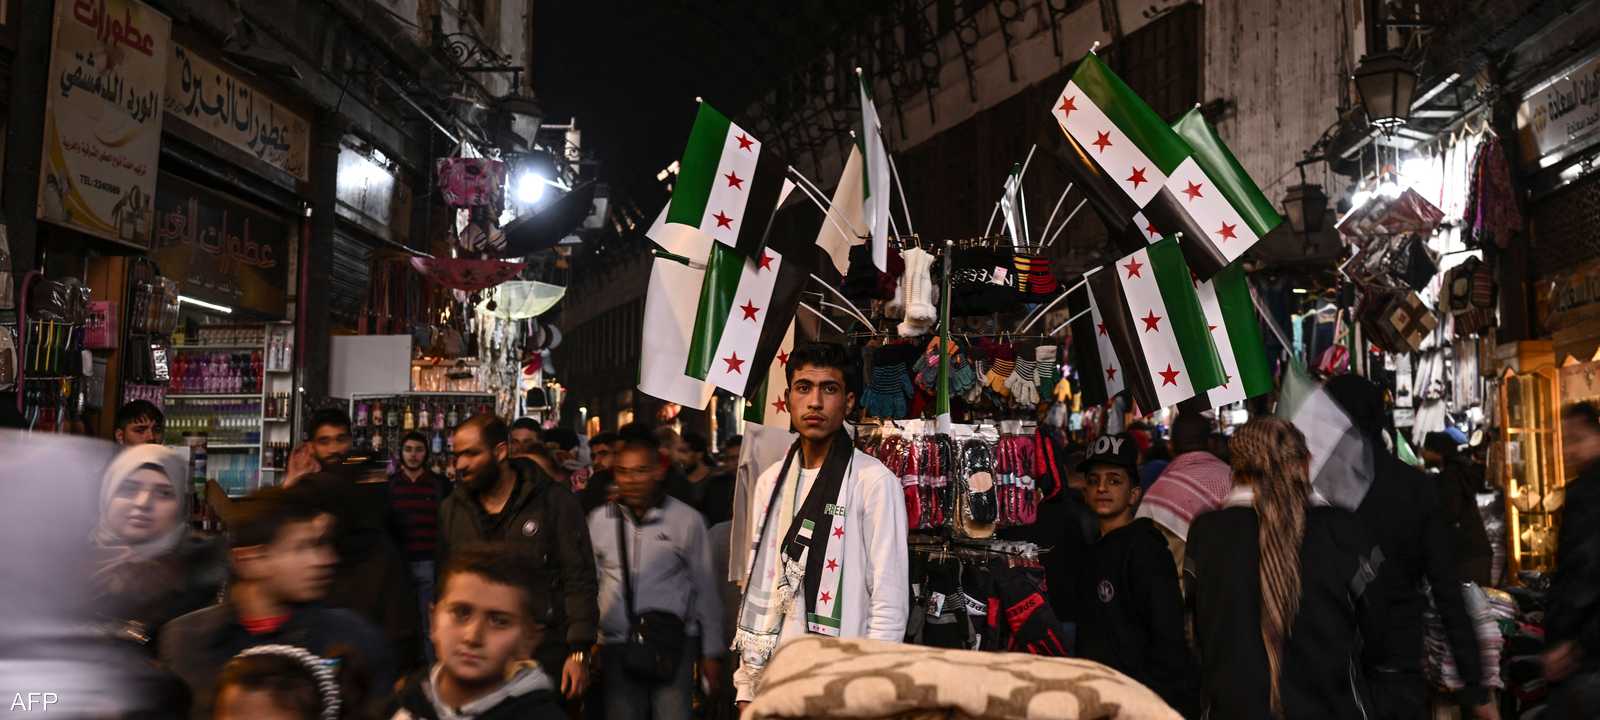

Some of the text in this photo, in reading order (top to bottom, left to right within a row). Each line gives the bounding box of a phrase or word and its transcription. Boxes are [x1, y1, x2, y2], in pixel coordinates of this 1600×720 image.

[73, 0, 154, 56] عطورات
[60, 51, 160, 123] الورد الدمشقي
[1085, 435, 1126, 460] BOY
